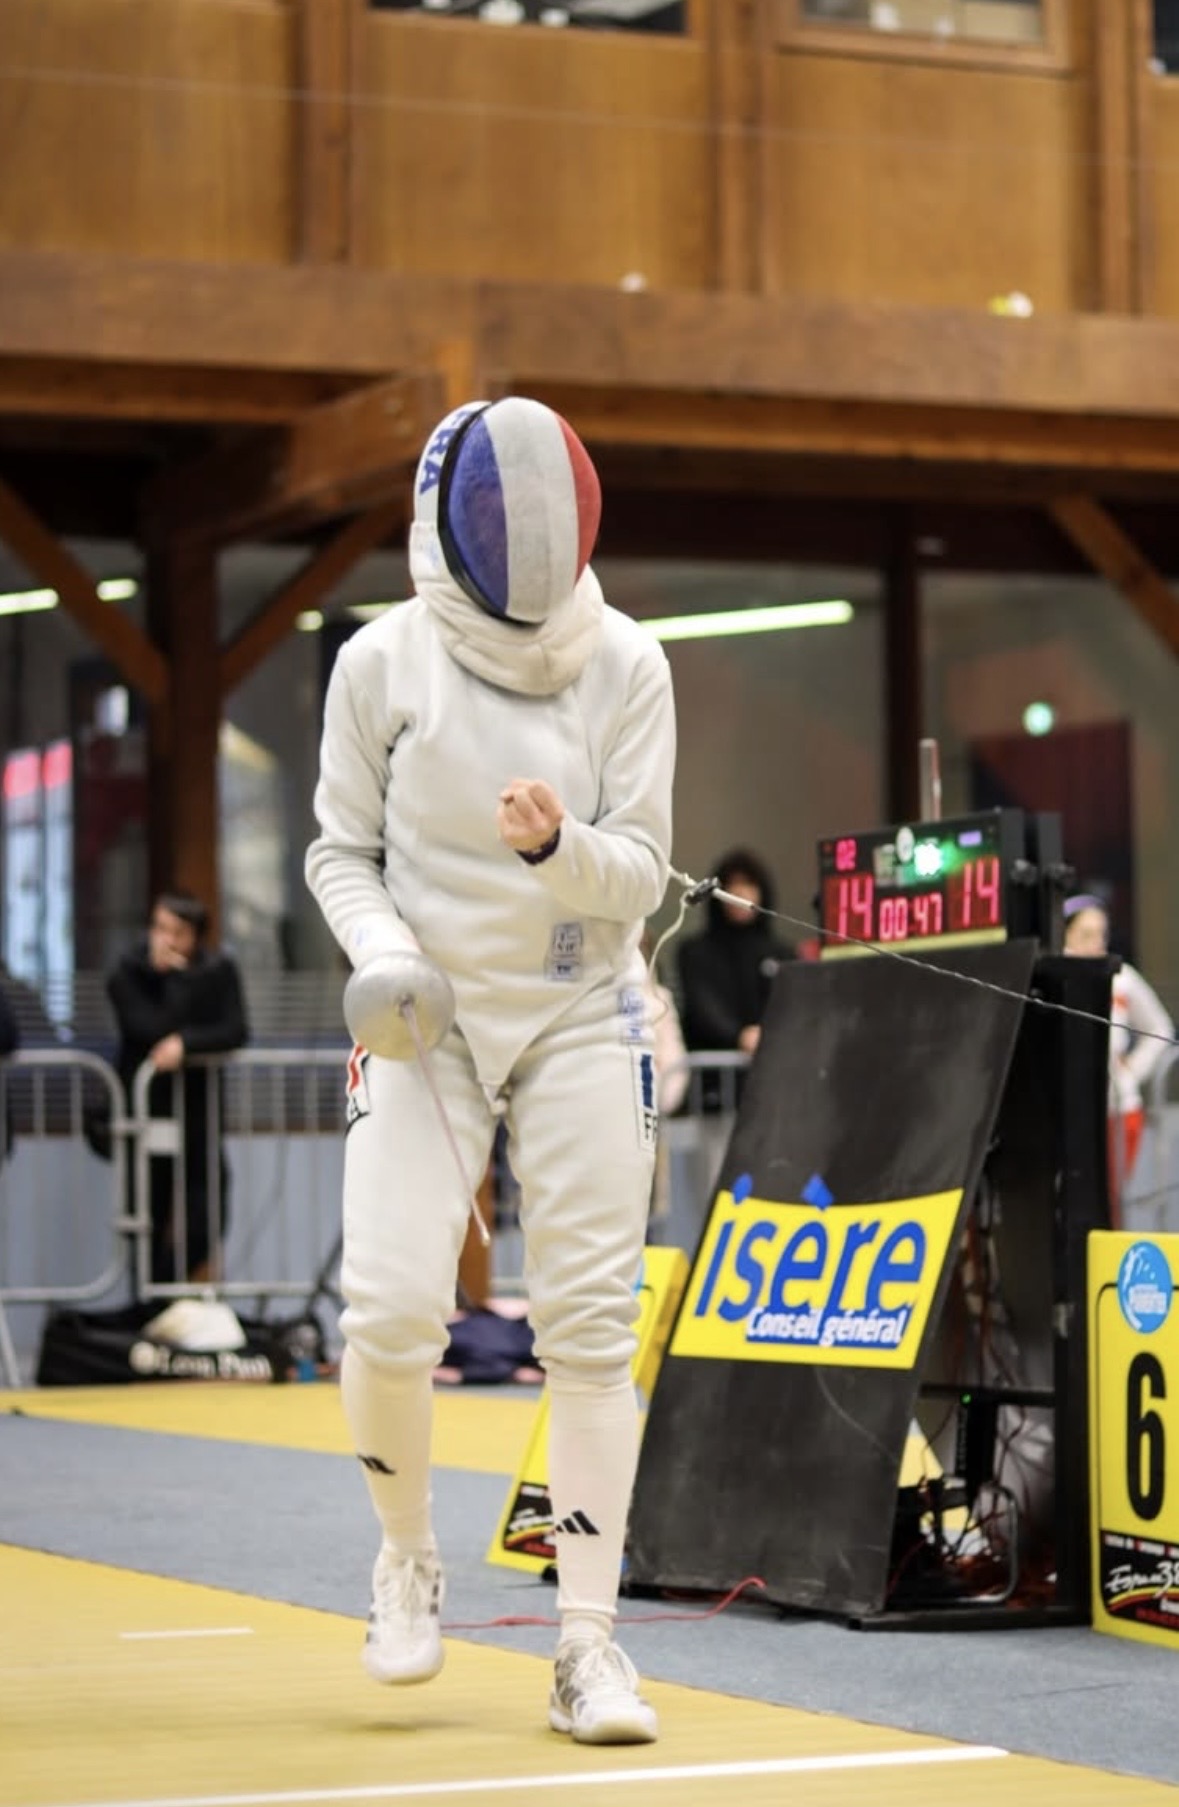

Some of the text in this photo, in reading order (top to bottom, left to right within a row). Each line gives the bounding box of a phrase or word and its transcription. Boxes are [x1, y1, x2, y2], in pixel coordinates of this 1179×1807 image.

[835, 839, 857, 871] 02
[839, 876, 873, 940] 14
[963, 857, 999, 927] 14
[746, 1304, 908, 1347] Conseil général
[1127, 1351, 1166, 1521] 6
